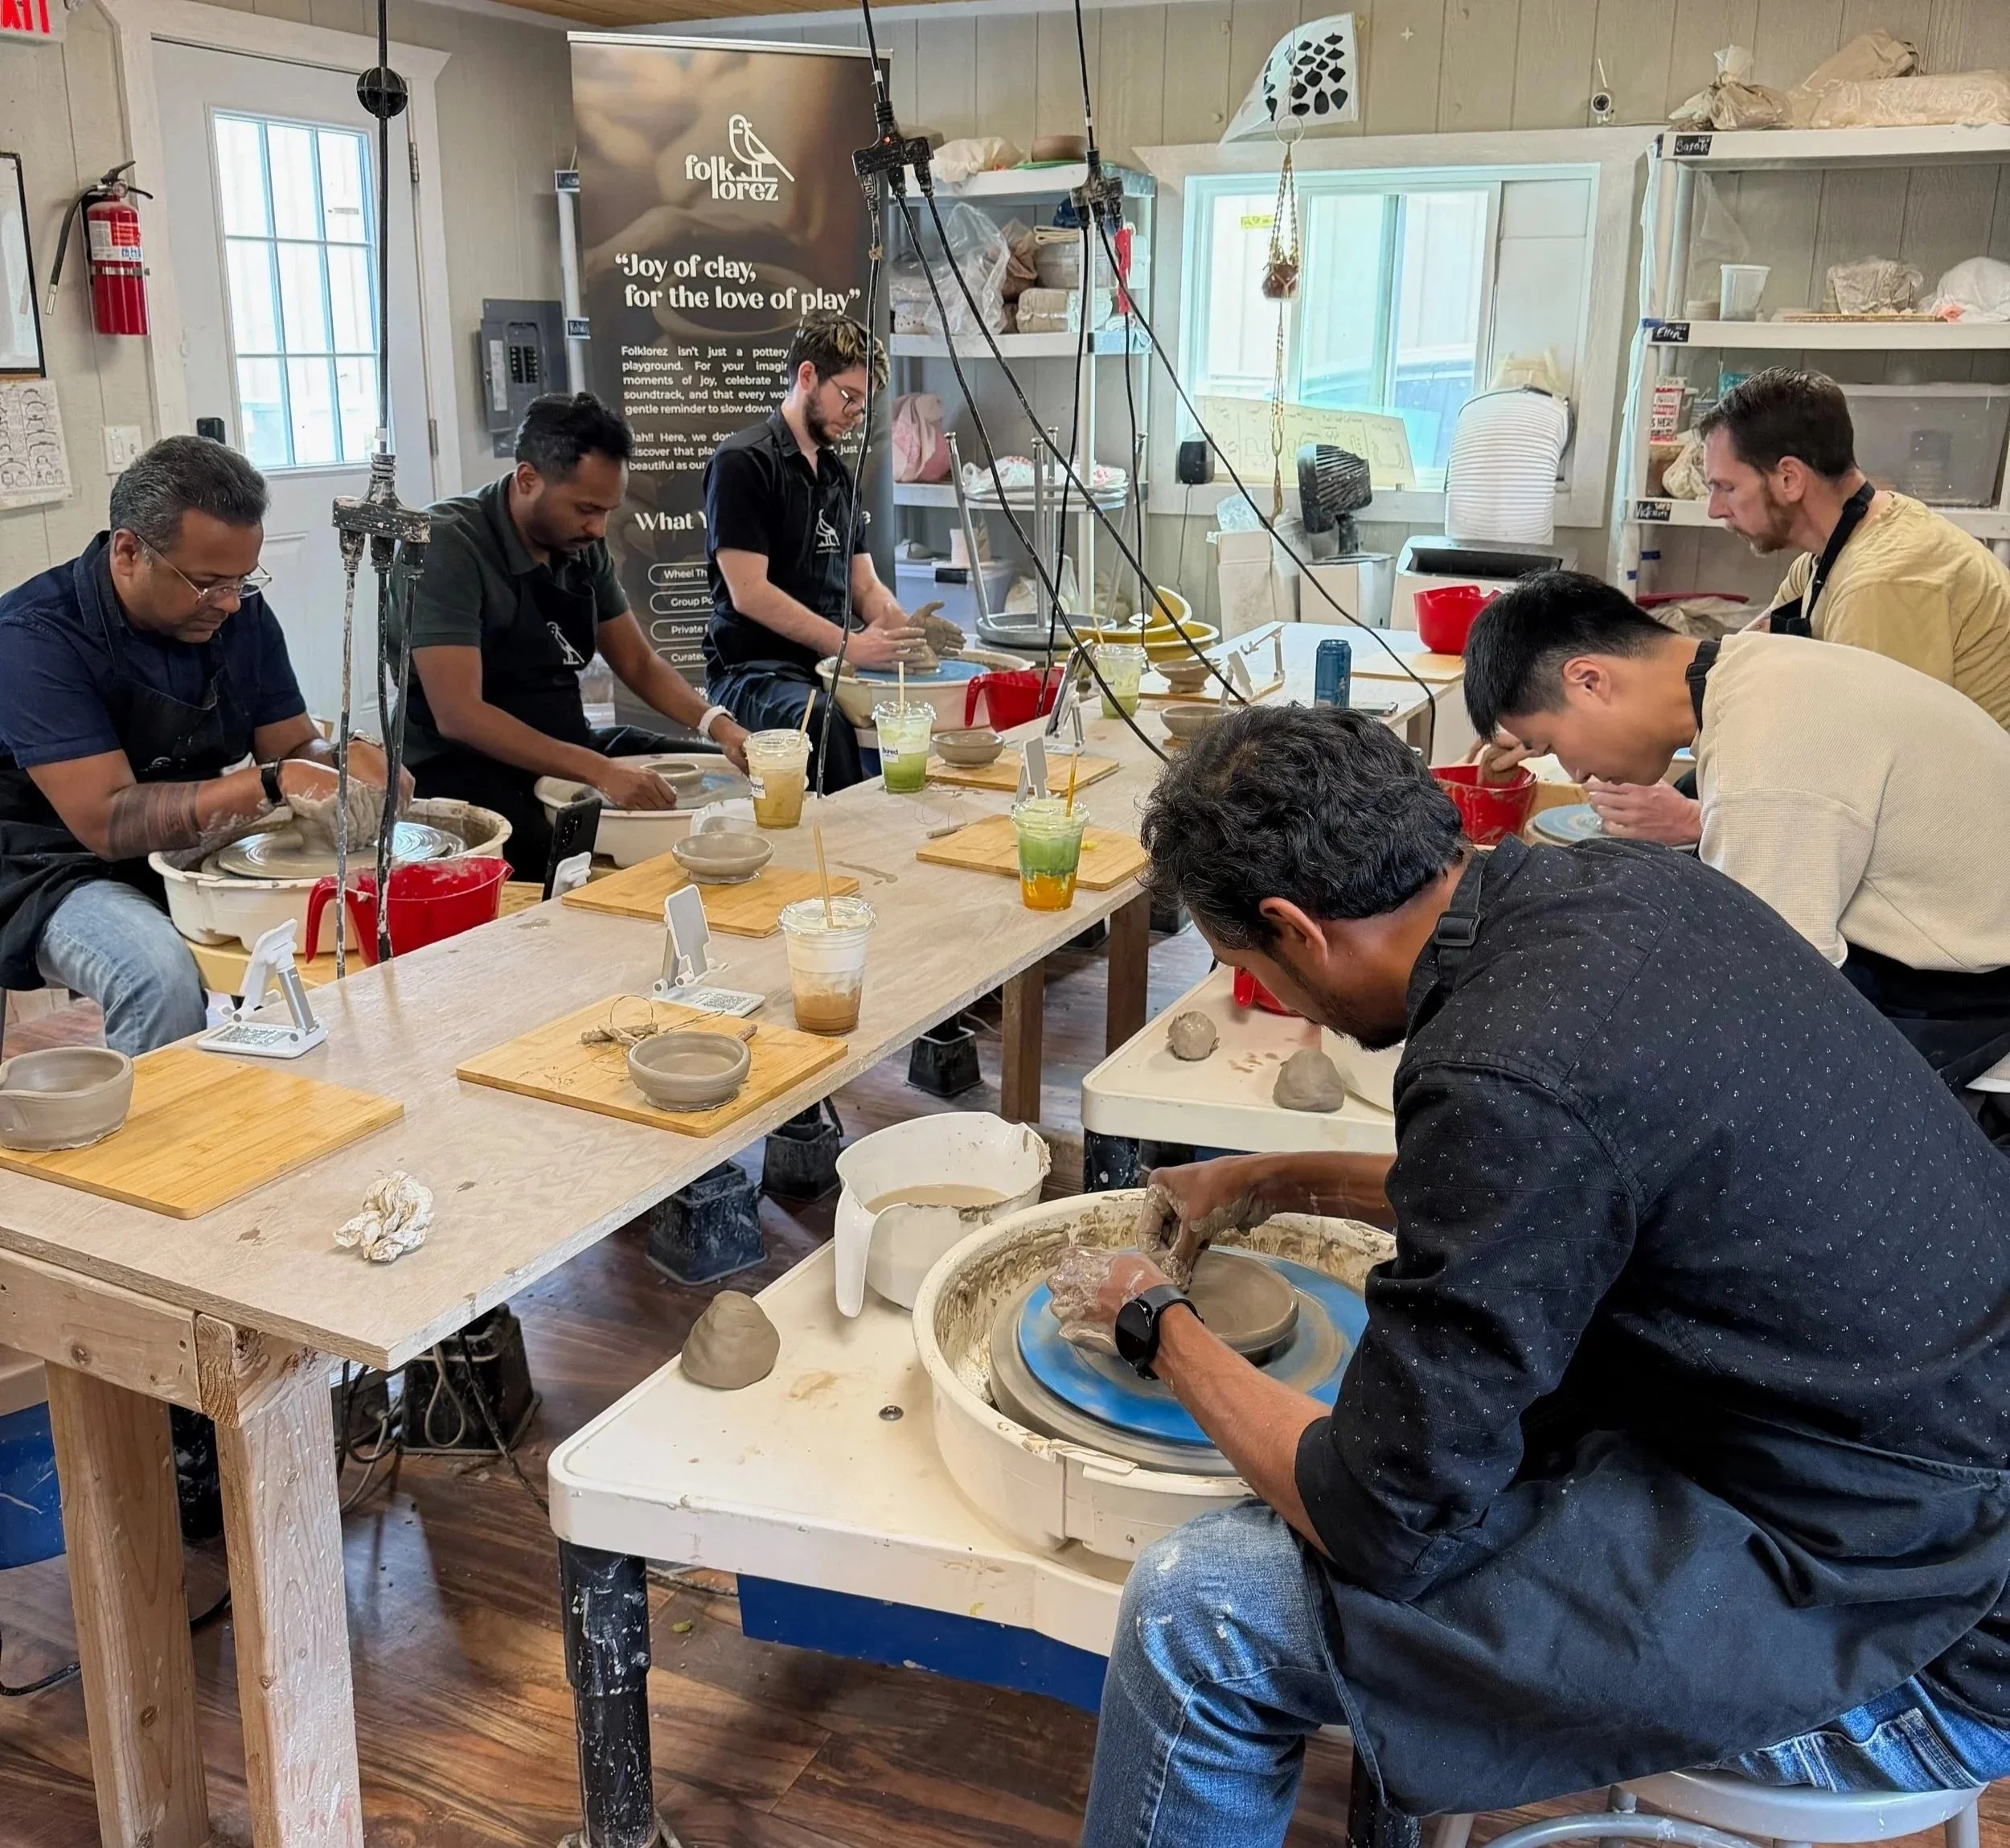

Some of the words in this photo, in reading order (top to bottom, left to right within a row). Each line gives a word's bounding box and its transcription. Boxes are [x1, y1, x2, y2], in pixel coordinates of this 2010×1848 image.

[685, 154, 736, 182] folk
[673, 254, 701, 278] of
[704, 255, 757, 285] clay,
[625, 284, 663, 308] for
[669, 285, 710, 309] the
[716, 285, 764, 309] love
[769, 287, 798, 310] of
[621, 346, 669, 356] Folklorez
[677, 346, 699, 356] isn't
[708, 346, 728, 359] just
[736, 348, 744, 357] a
[752, 347, 790, 359] pottery
[621, 360, 684, 373] playground.
[694, 360, 712, 371] For
[721, 363, 745, 373] your
[622, 376, 674, 385] moments
[681, 375, 693, 385] of
[724, 375, 772, 385] celebrate
[623, 389, 685, 401] soundtrack,
[688, 390, 708, 400] and
[712, 389, 734, 400] that
[737, 391, 766, 401] every
[624, 404, 659, 417] gentle
[660, 404, 707, 414] reminder
[708, 405, 720, 414] to
[720, 404, 744, 414] slow
[744, 403, 776, 414] down.
[659, 433, 687, 443] Here,
[691, 433, 708, 442] we
[673, 447, 695, 457] that
[839, 444, 859, 456] just
[629, 461, 675, 471] beautiful
[675, 462, 687, 471] as
[634, 511, 695, 531] What
[663, 569, 694, 579] Wheel
[670, 598, 700, 607] Group
[671, 625, 703, 634] Private
